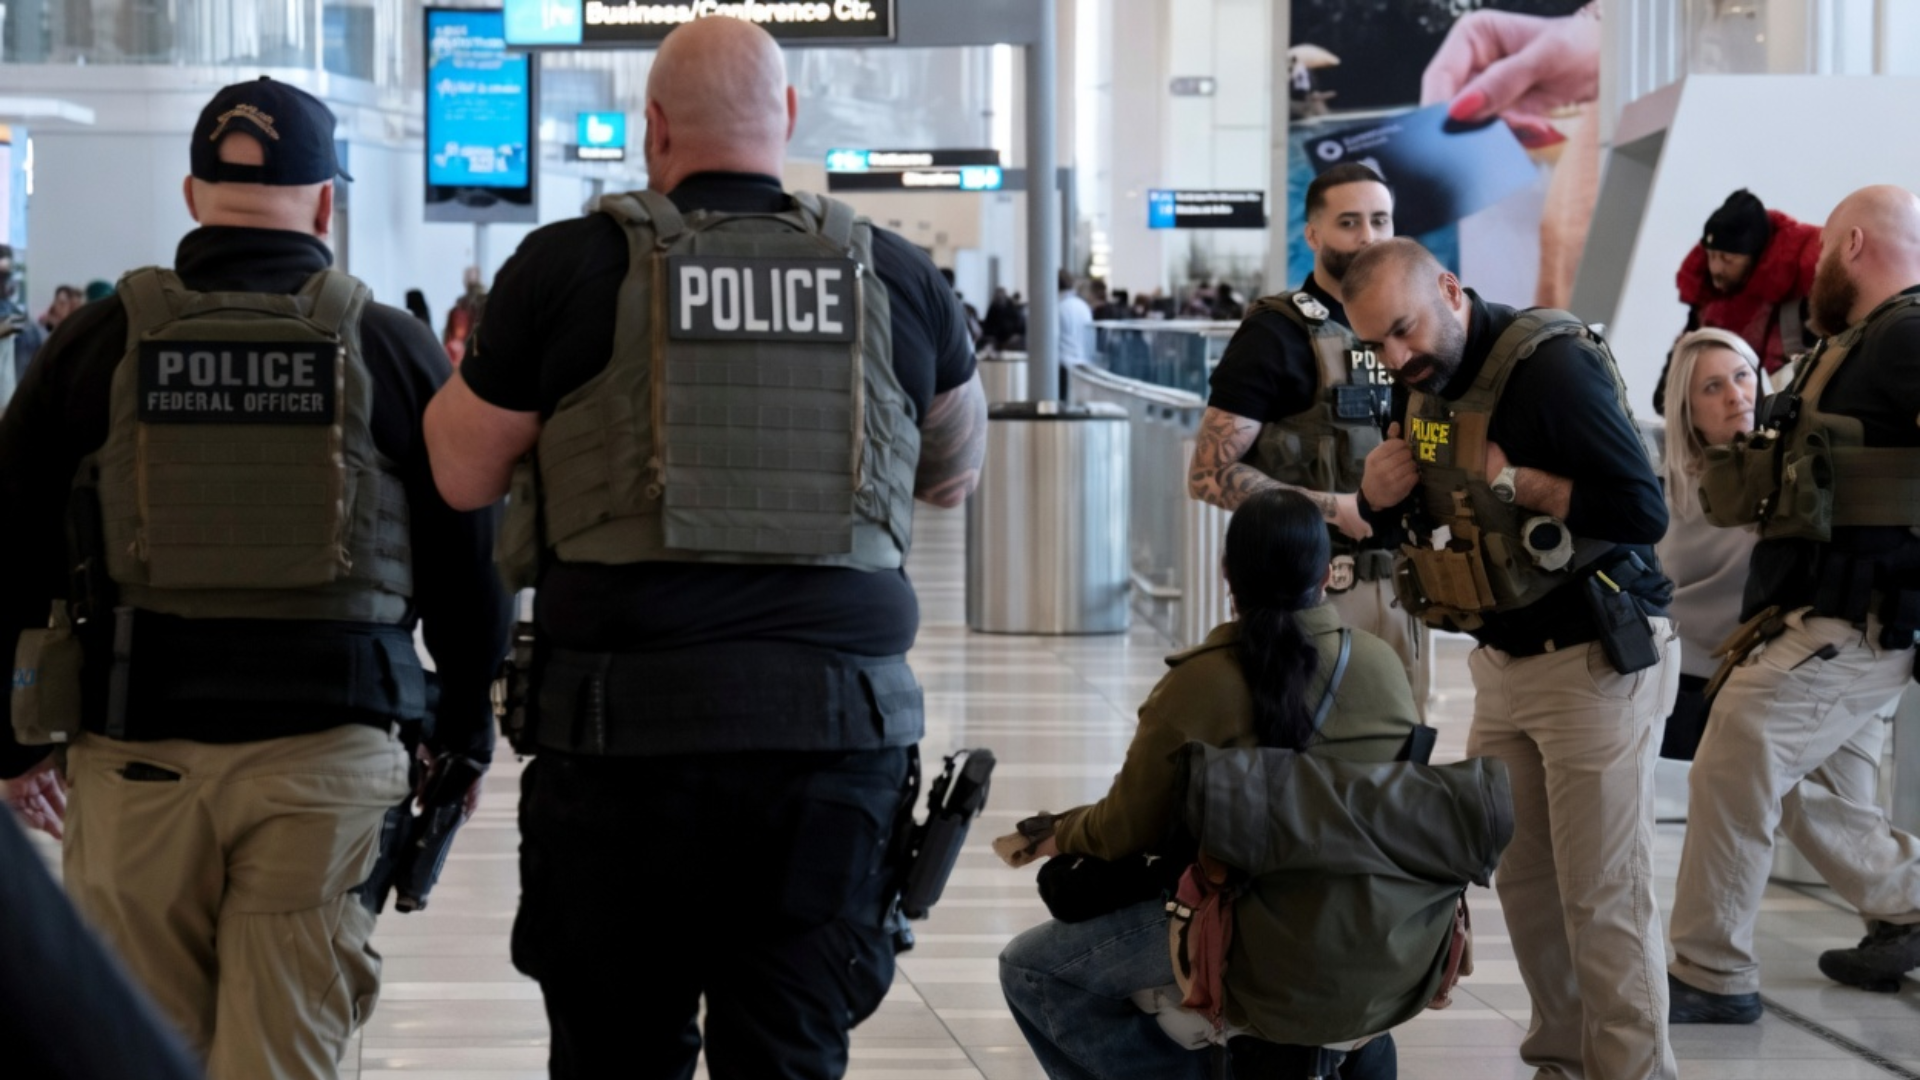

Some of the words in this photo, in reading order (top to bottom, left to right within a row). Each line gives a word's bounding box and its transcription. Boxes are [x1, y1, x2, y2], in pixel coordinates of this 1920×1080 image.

[835, 0, 877, 21] Ctr.
[680, 265, 843, 334] POLICE
[158, 351, 316, 387] POLICE
[147, 391, 235, 411] FEDERAL
[244, 392, 324, 412] OFFICER
